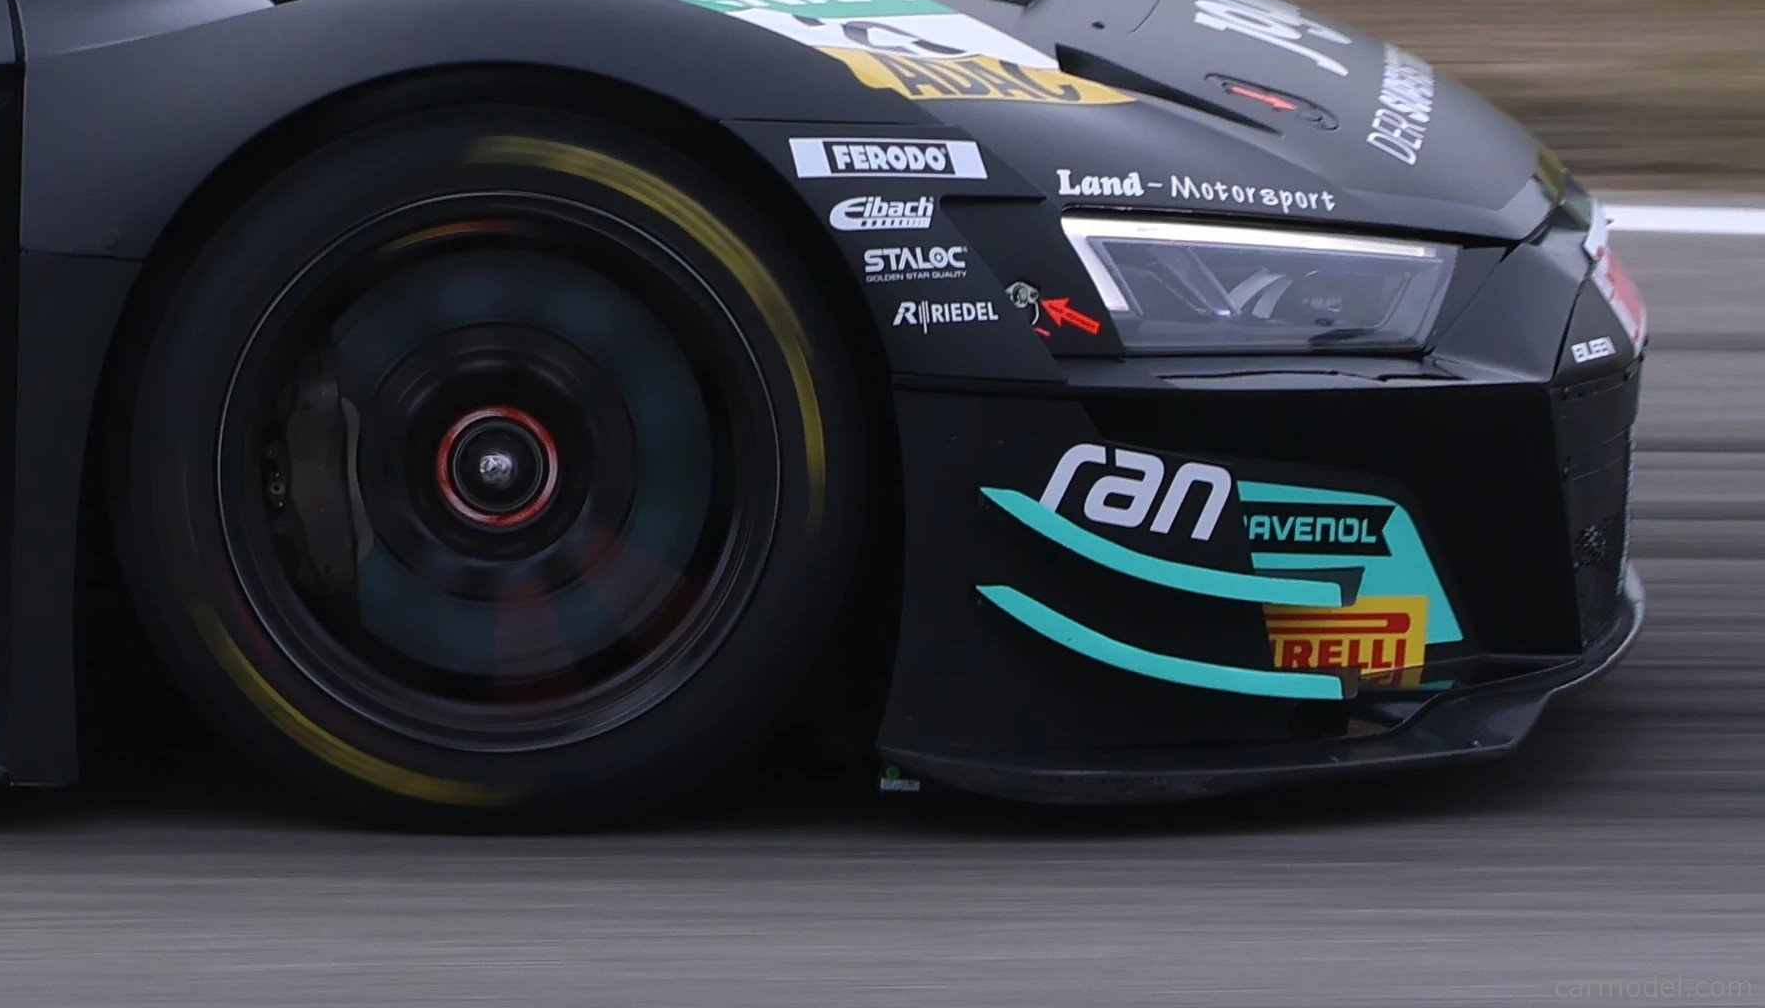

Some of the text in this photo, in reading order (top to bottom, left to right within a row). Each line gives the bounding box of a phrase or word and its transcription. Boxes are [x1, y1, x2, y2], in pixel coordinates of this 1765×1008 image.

[831, 143, 947, 173] FERODO
[1056, 168, 1145, 197] Land
[1170, 174, 1337, 211] Motorsport
[829, 195, 934, 231] Eibach
[930, 300, 1000, 324] RIEDEL
[1038, 443, 1232, 541] ran
[1243, 514, 1378, 544] AVENOL
[1269, 637, 1409, 674] RELLI
